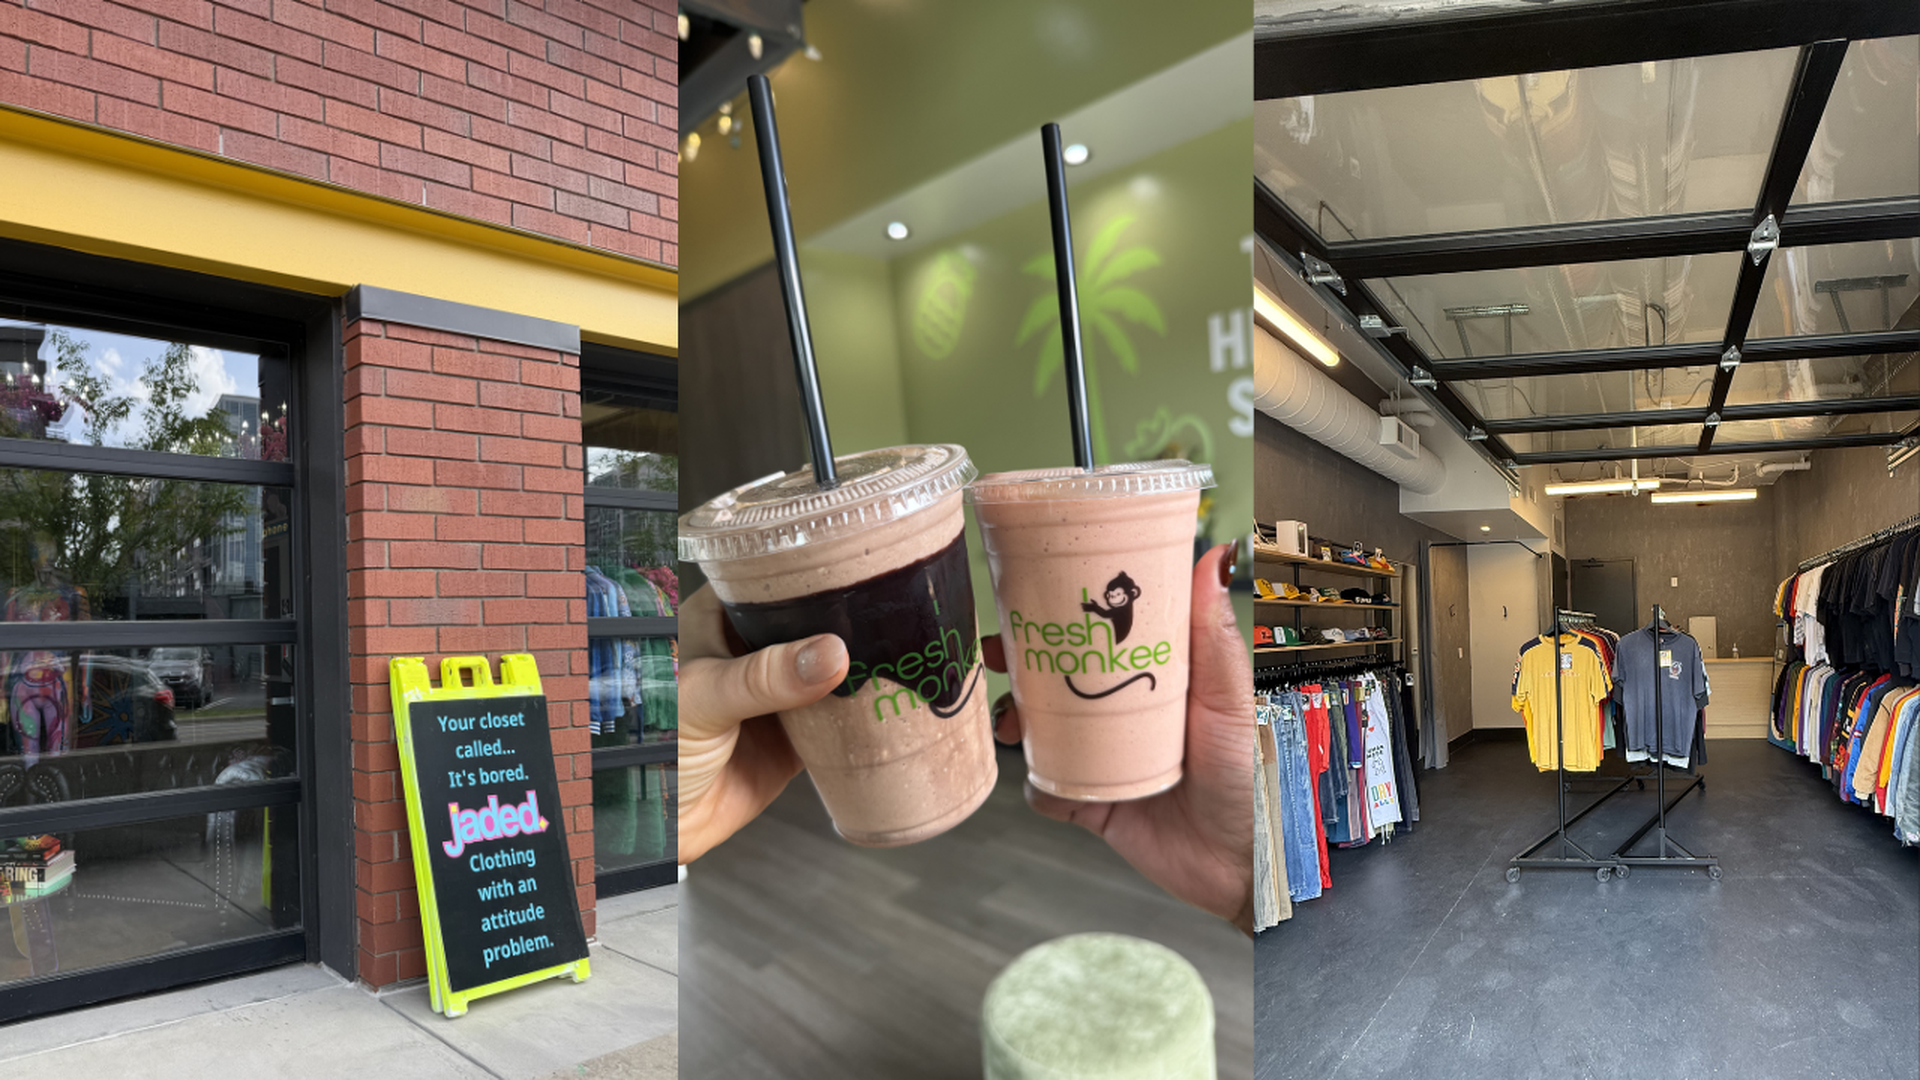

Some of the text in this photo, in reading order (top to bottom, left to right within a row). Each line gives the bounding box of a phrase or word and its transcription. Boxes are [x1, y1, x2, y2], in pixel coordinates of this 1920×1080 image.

[1010, 587, 1114, 647] fresh
[846, 600, 965, 698] fresh
[1025, 641, 1171, 675] monkee
[437, 711, 525, 733] Your closet
[455, 740, 515, 759] called...
[448, 764, 529, 789] It's bored.
[1370, 781, 1391, 802] DRY
[442, 790, 549, 858] jaded.
[469, 848, 536, 873] Clothing
[0, 866, 38, 882] RING
[477, 877, 537, 902] with an
[480, 904, 545, 932] attitude
[483, 935, 554, 968] problem.
